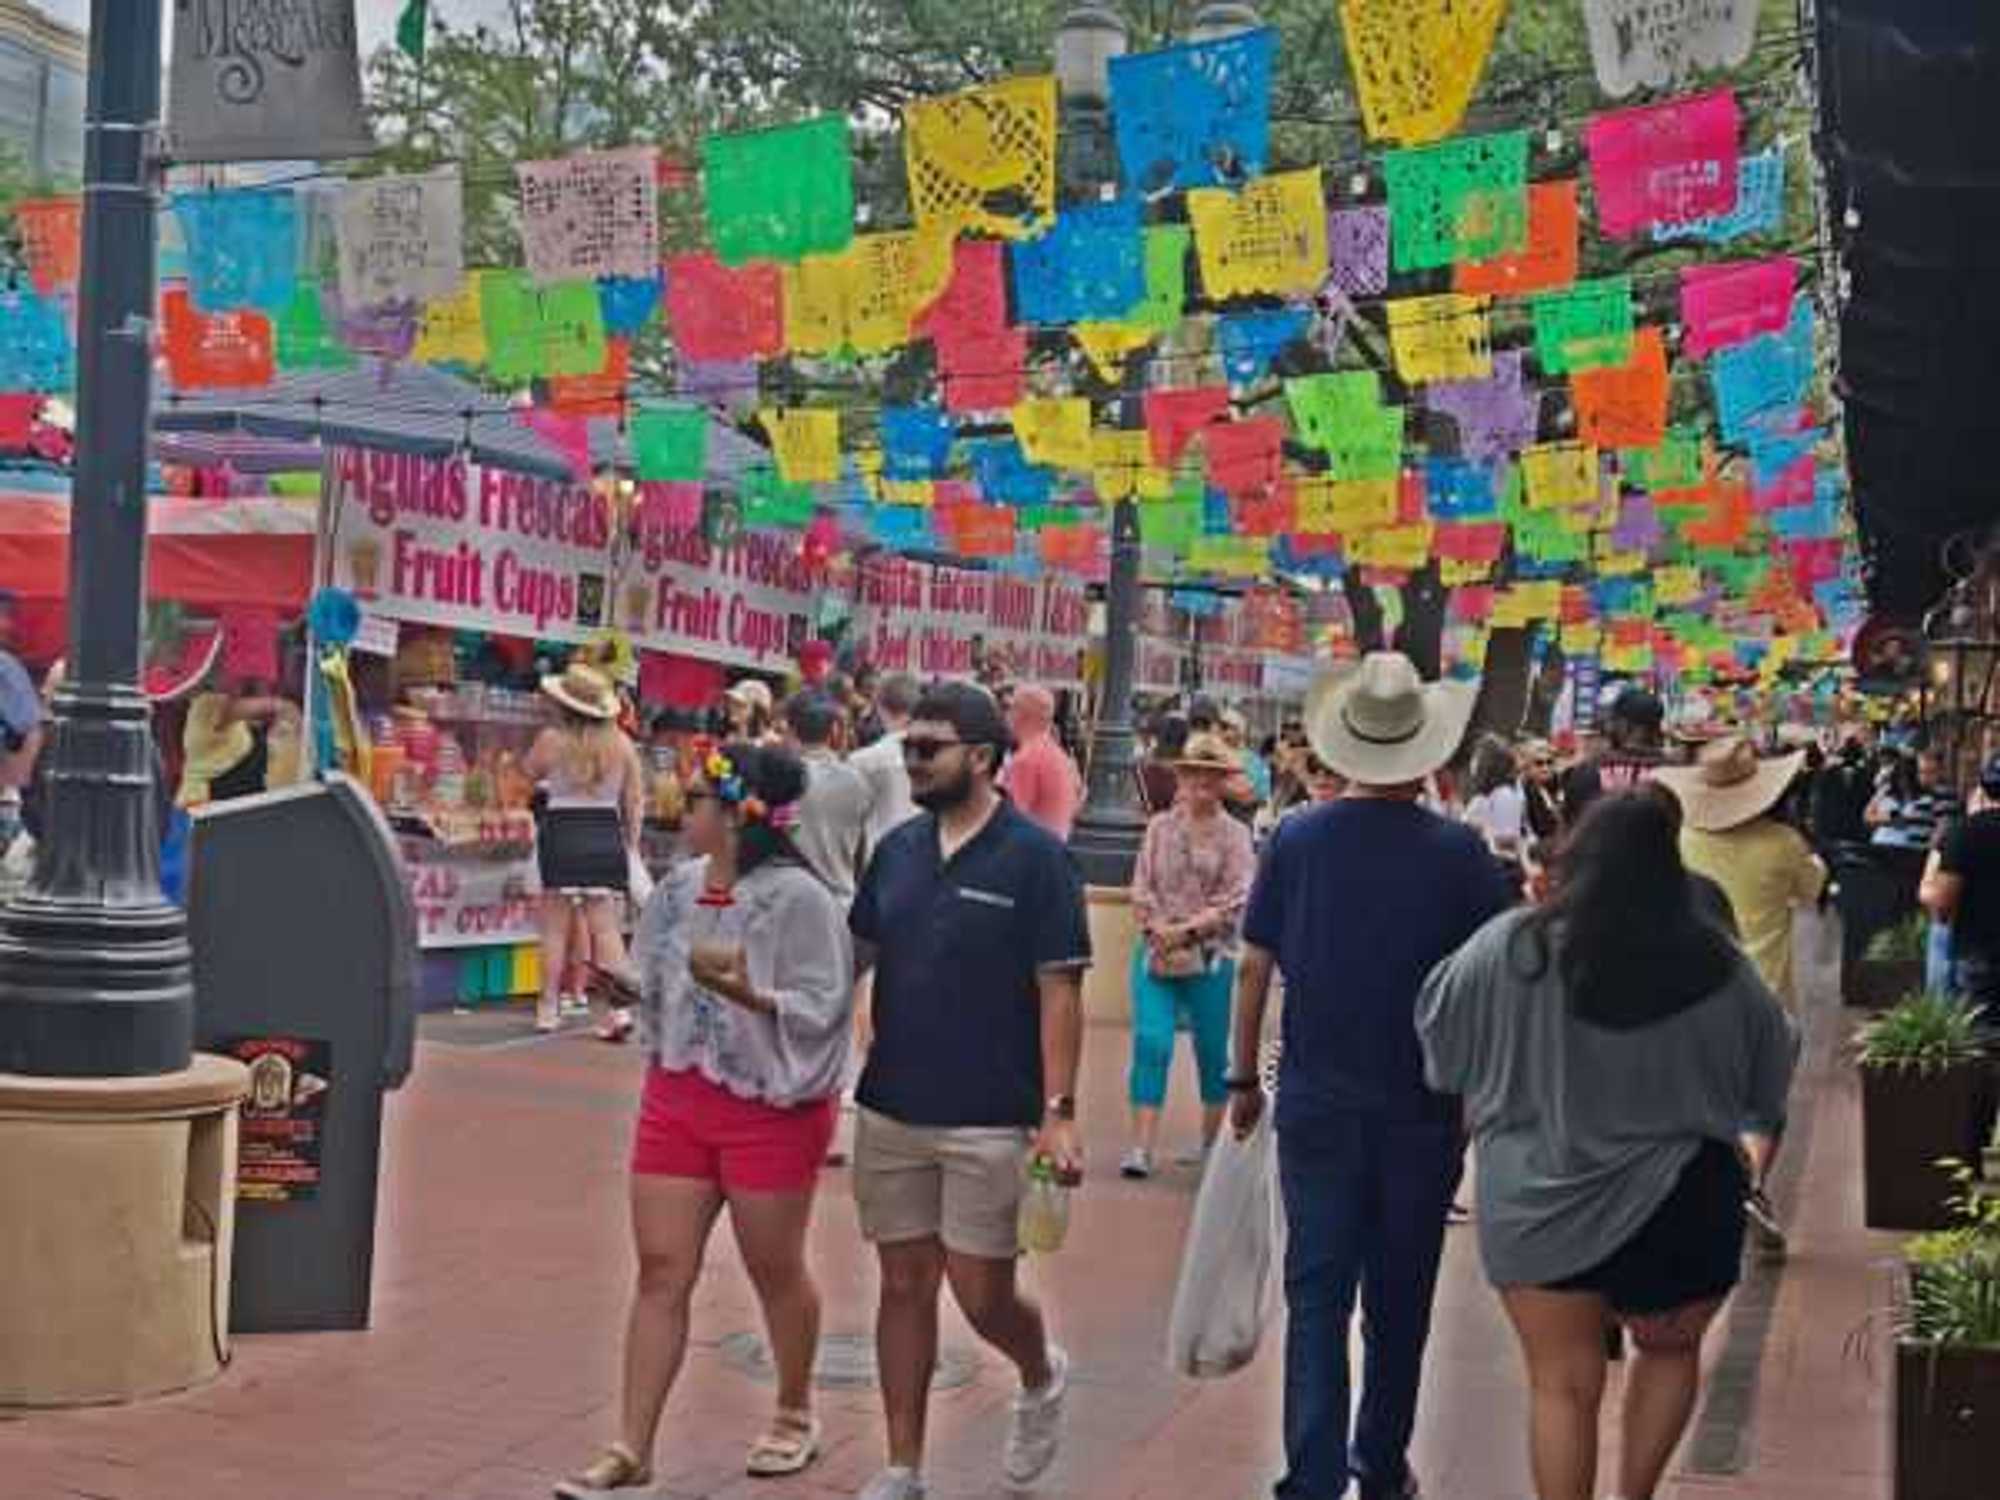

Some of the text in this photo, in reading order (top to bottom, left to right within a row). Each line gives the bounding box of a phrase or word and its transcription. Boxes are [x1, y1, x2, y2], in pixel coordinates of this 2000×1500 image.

[336, 447, 608, 551] Aguas Frescas
[393, 530, 574, 631] Fruit Cups
[657, 575, 785, 662] Fruit Cups
